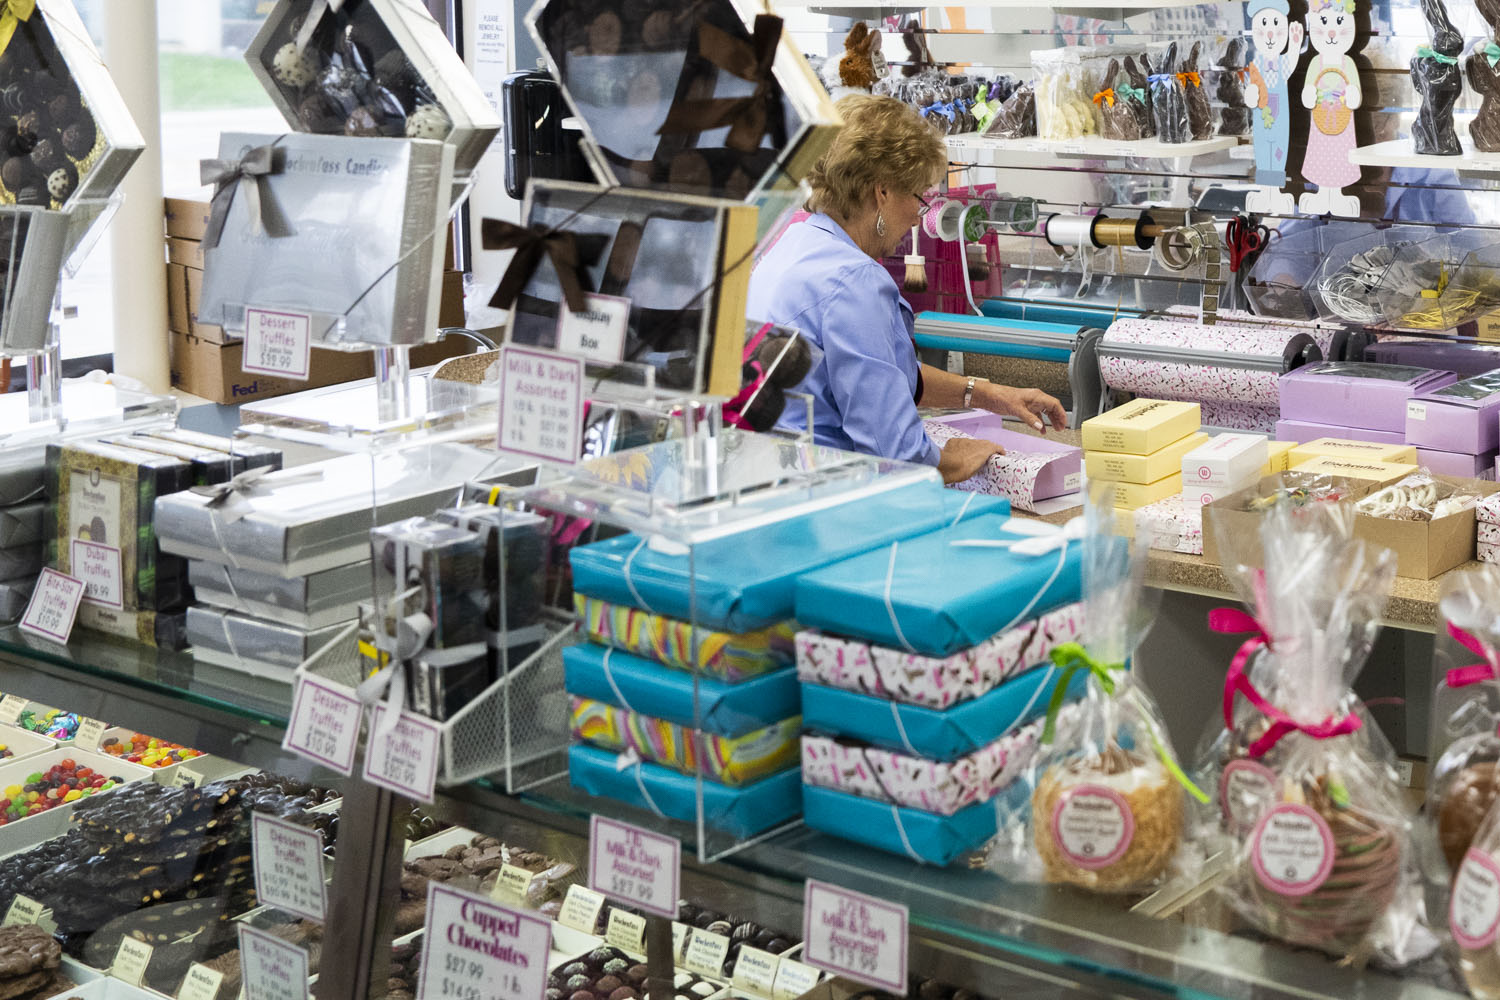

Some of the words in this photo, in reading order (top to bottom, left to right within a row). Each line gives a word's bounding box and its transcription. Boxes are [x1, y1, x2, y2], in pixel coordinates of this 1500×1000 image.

[260, 314, 295, 330] Dessert
[260, 331, 295, 346] Truffles
[581, 334, 599, 349] Box
[509, 359, 532, 376] Milk
[536, 362, 544, 377] &
[551, 365, 577, 384] Dark
[515, 380, 568, 400] Assorted
[86, 547, 108, 561] Dubai
[83, 561, 111, 579] Truffles
[46, 575, 75, 596] Bite-Size
[43, 591, 68, 611] Truffles
[313, 688, 349, 715] Dessert
[310, 706, 344, 733] Truffles
[386, 733, 422, 761] Truffles
[269, 828, 306, 849] Dessert
[273, 845, 306, 866] Truffles
[461, 899, 520, 938] Cupped
[447, 923, 529, 969] Chocolates
[445, 952, 484, 980] $27.99
